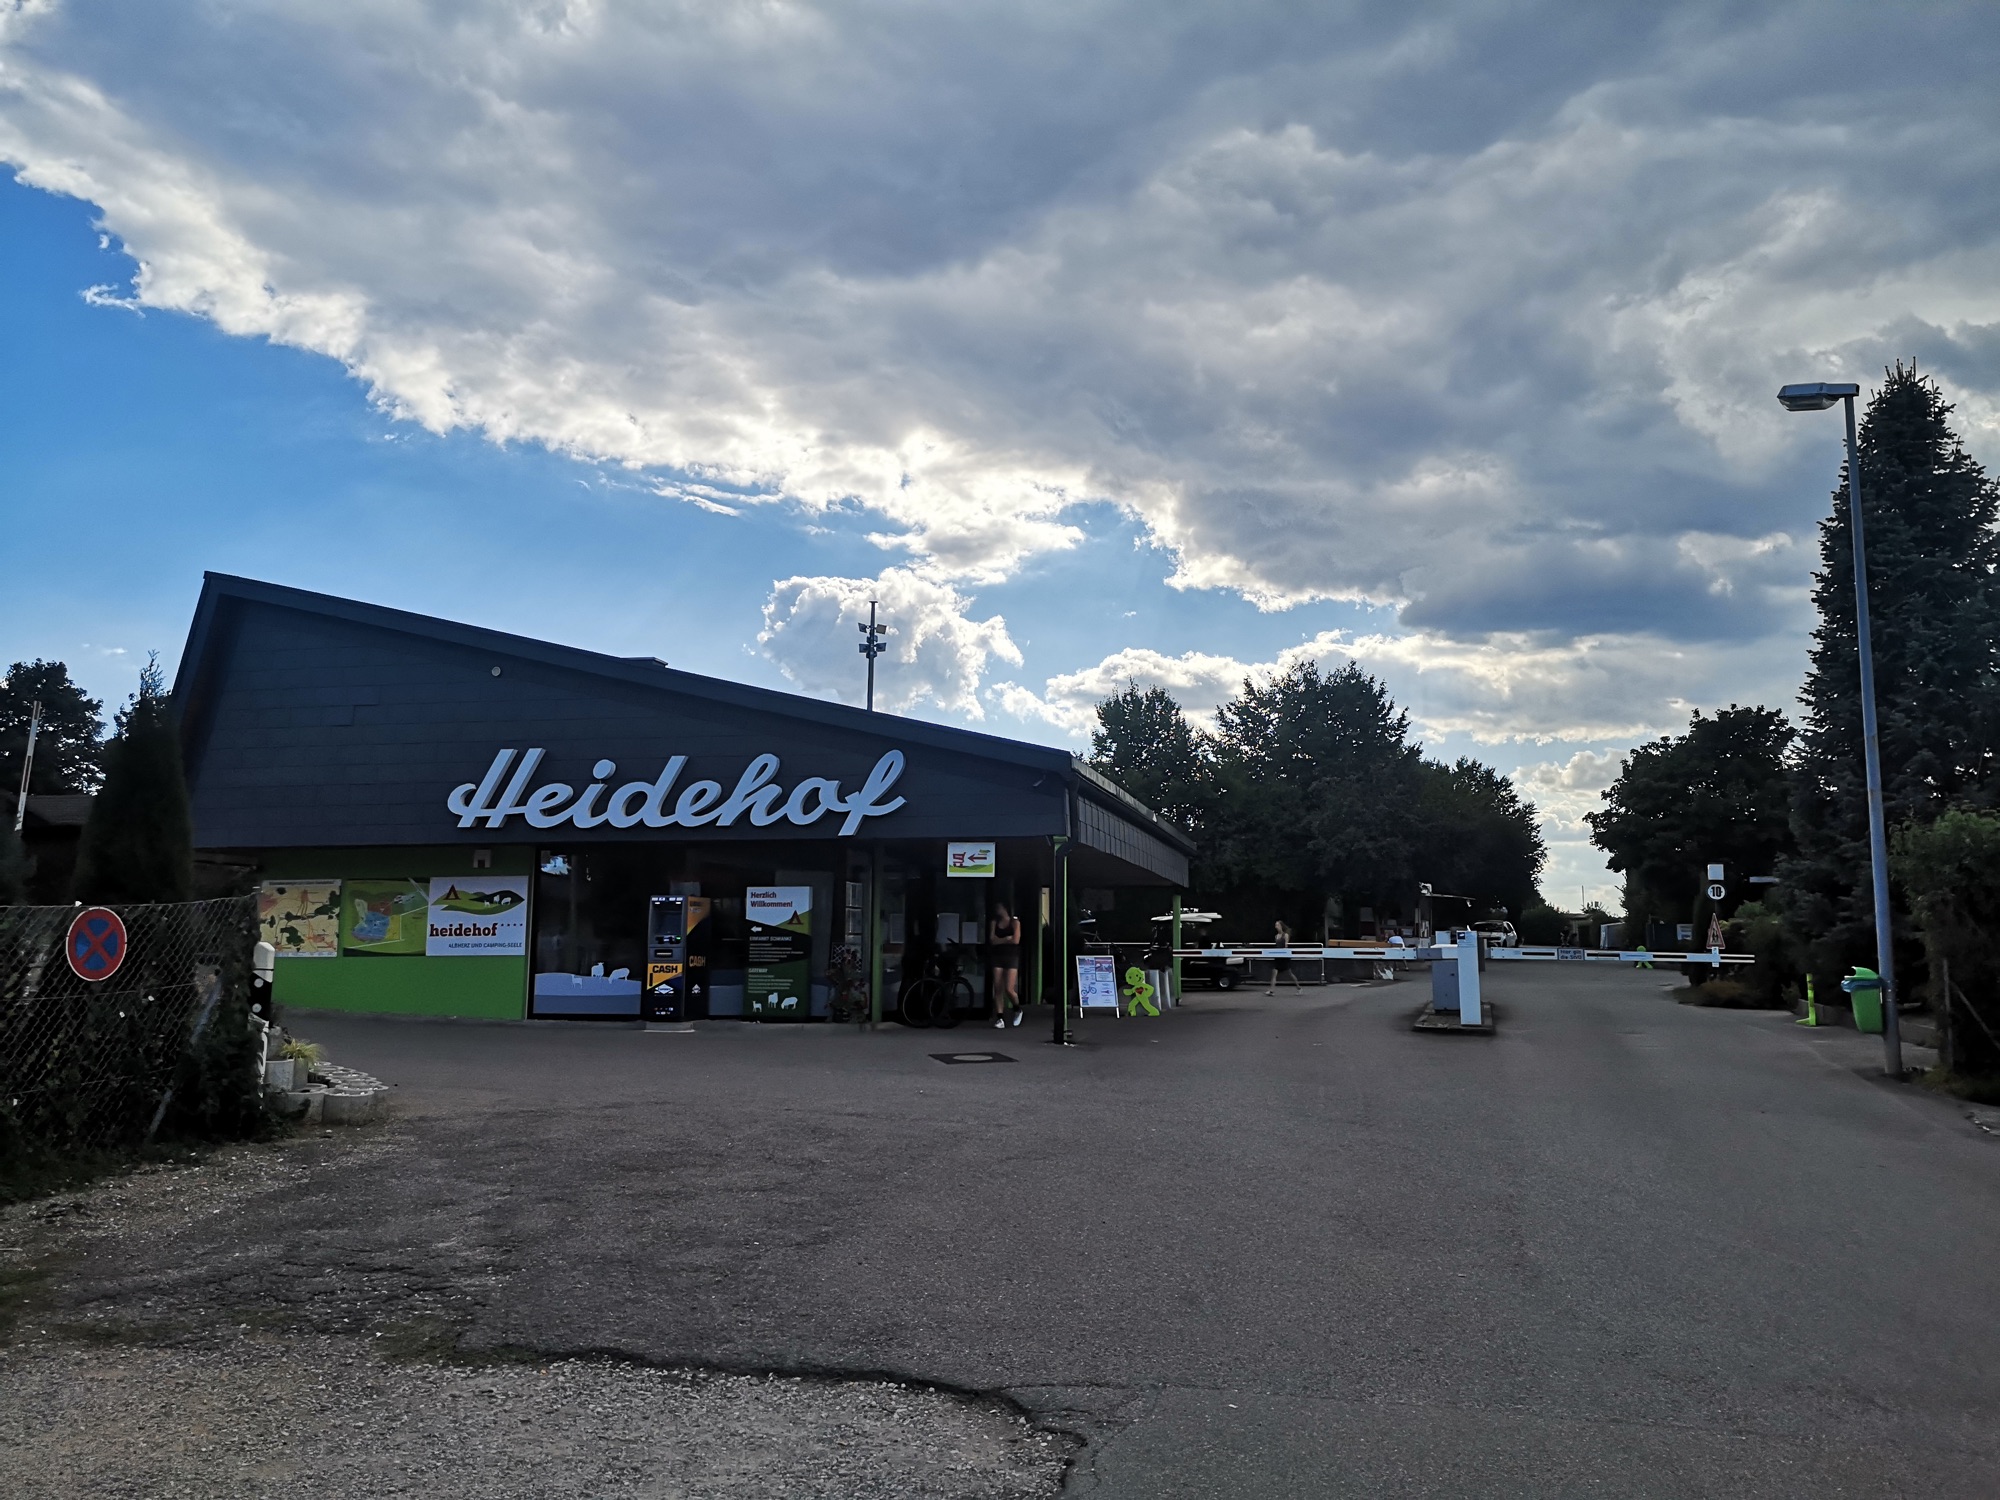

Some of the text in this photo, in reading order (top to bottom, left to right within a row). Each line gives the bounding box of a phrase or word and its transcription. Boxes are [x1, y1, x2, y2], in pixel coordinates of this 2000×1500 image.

[447, 747, 907, 837] Heidehof
[750, 891, 777, 899] Herzlich
[1711, 886, 1722, 897] 10
[429, 923, 498, 937] heidehof
[689, 955, 706, 967] CASH
[652, 965, 678, 973] CASH
